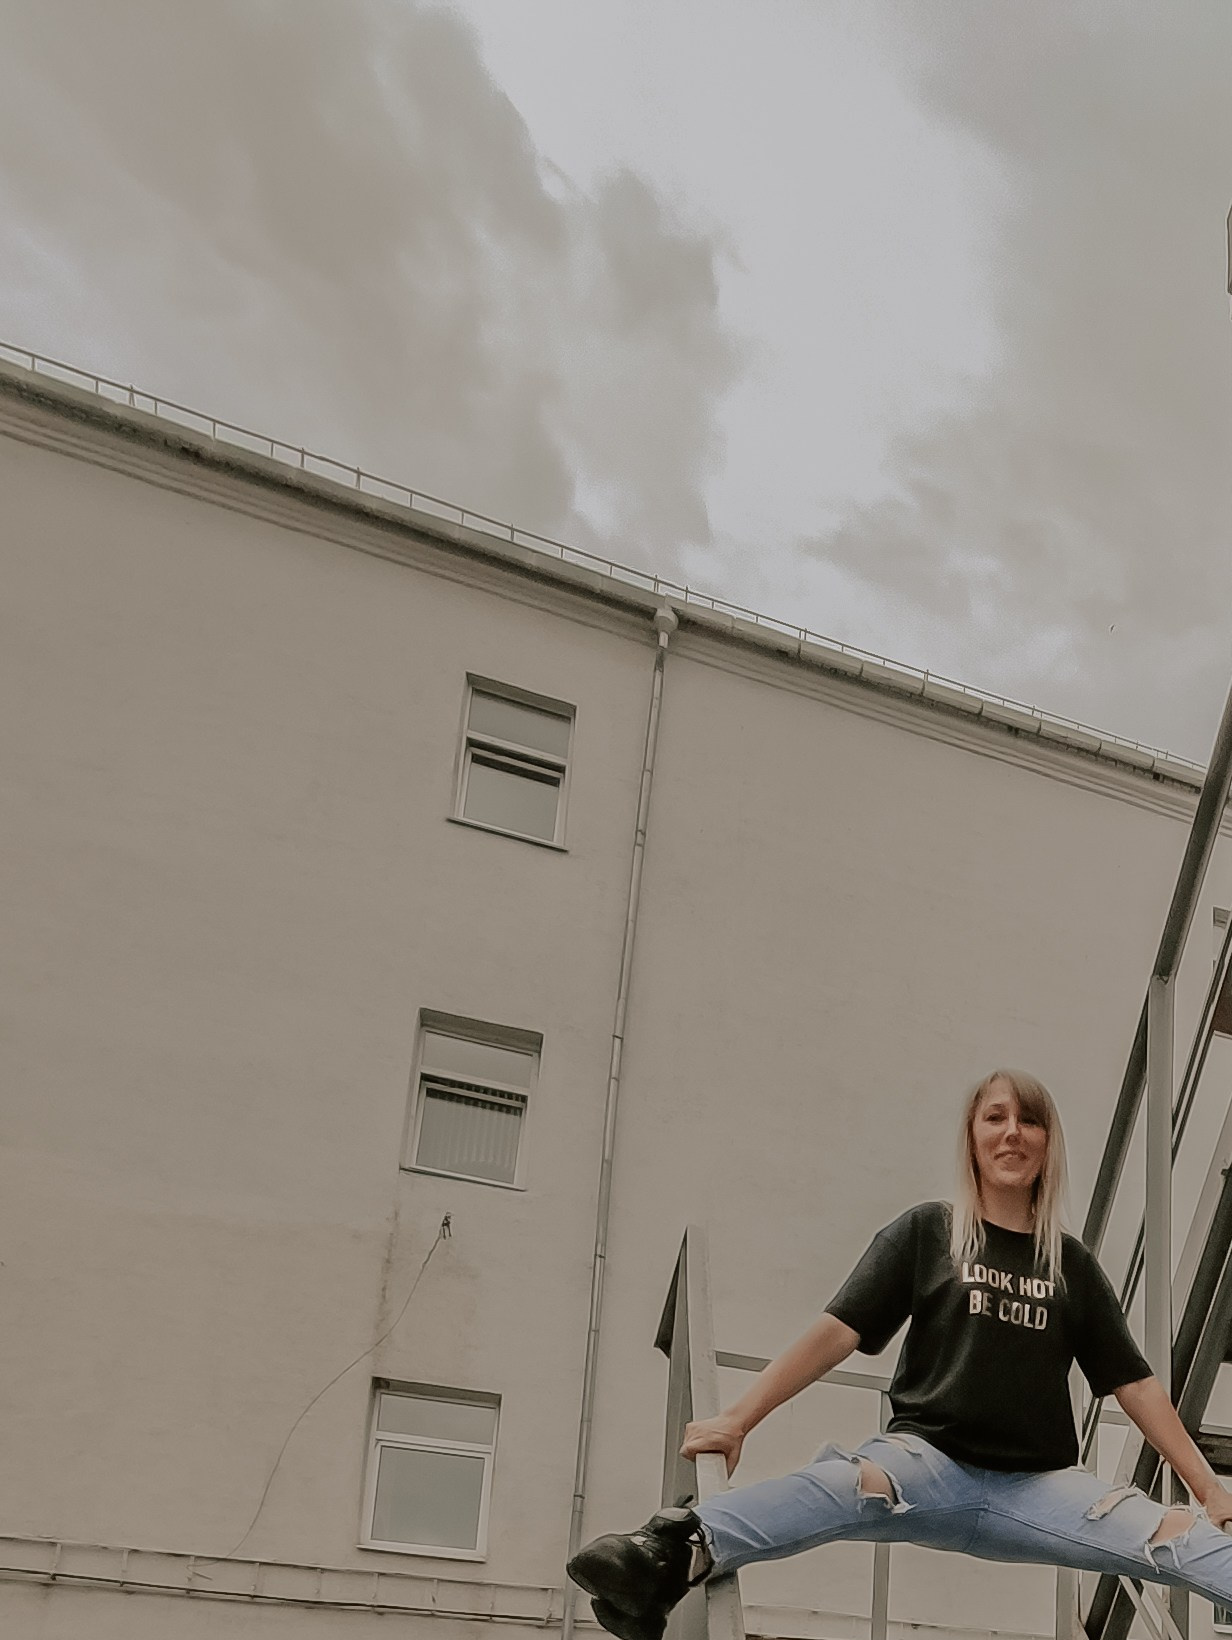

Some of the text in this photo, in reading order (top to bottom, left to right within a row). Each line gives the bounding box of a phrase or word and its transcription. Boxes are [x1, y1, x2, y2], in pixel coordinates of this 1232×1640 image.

[962, 1261, 1056, 1299] LOOK HOT
[969, 1289, 1048, 1330] BE COLD
